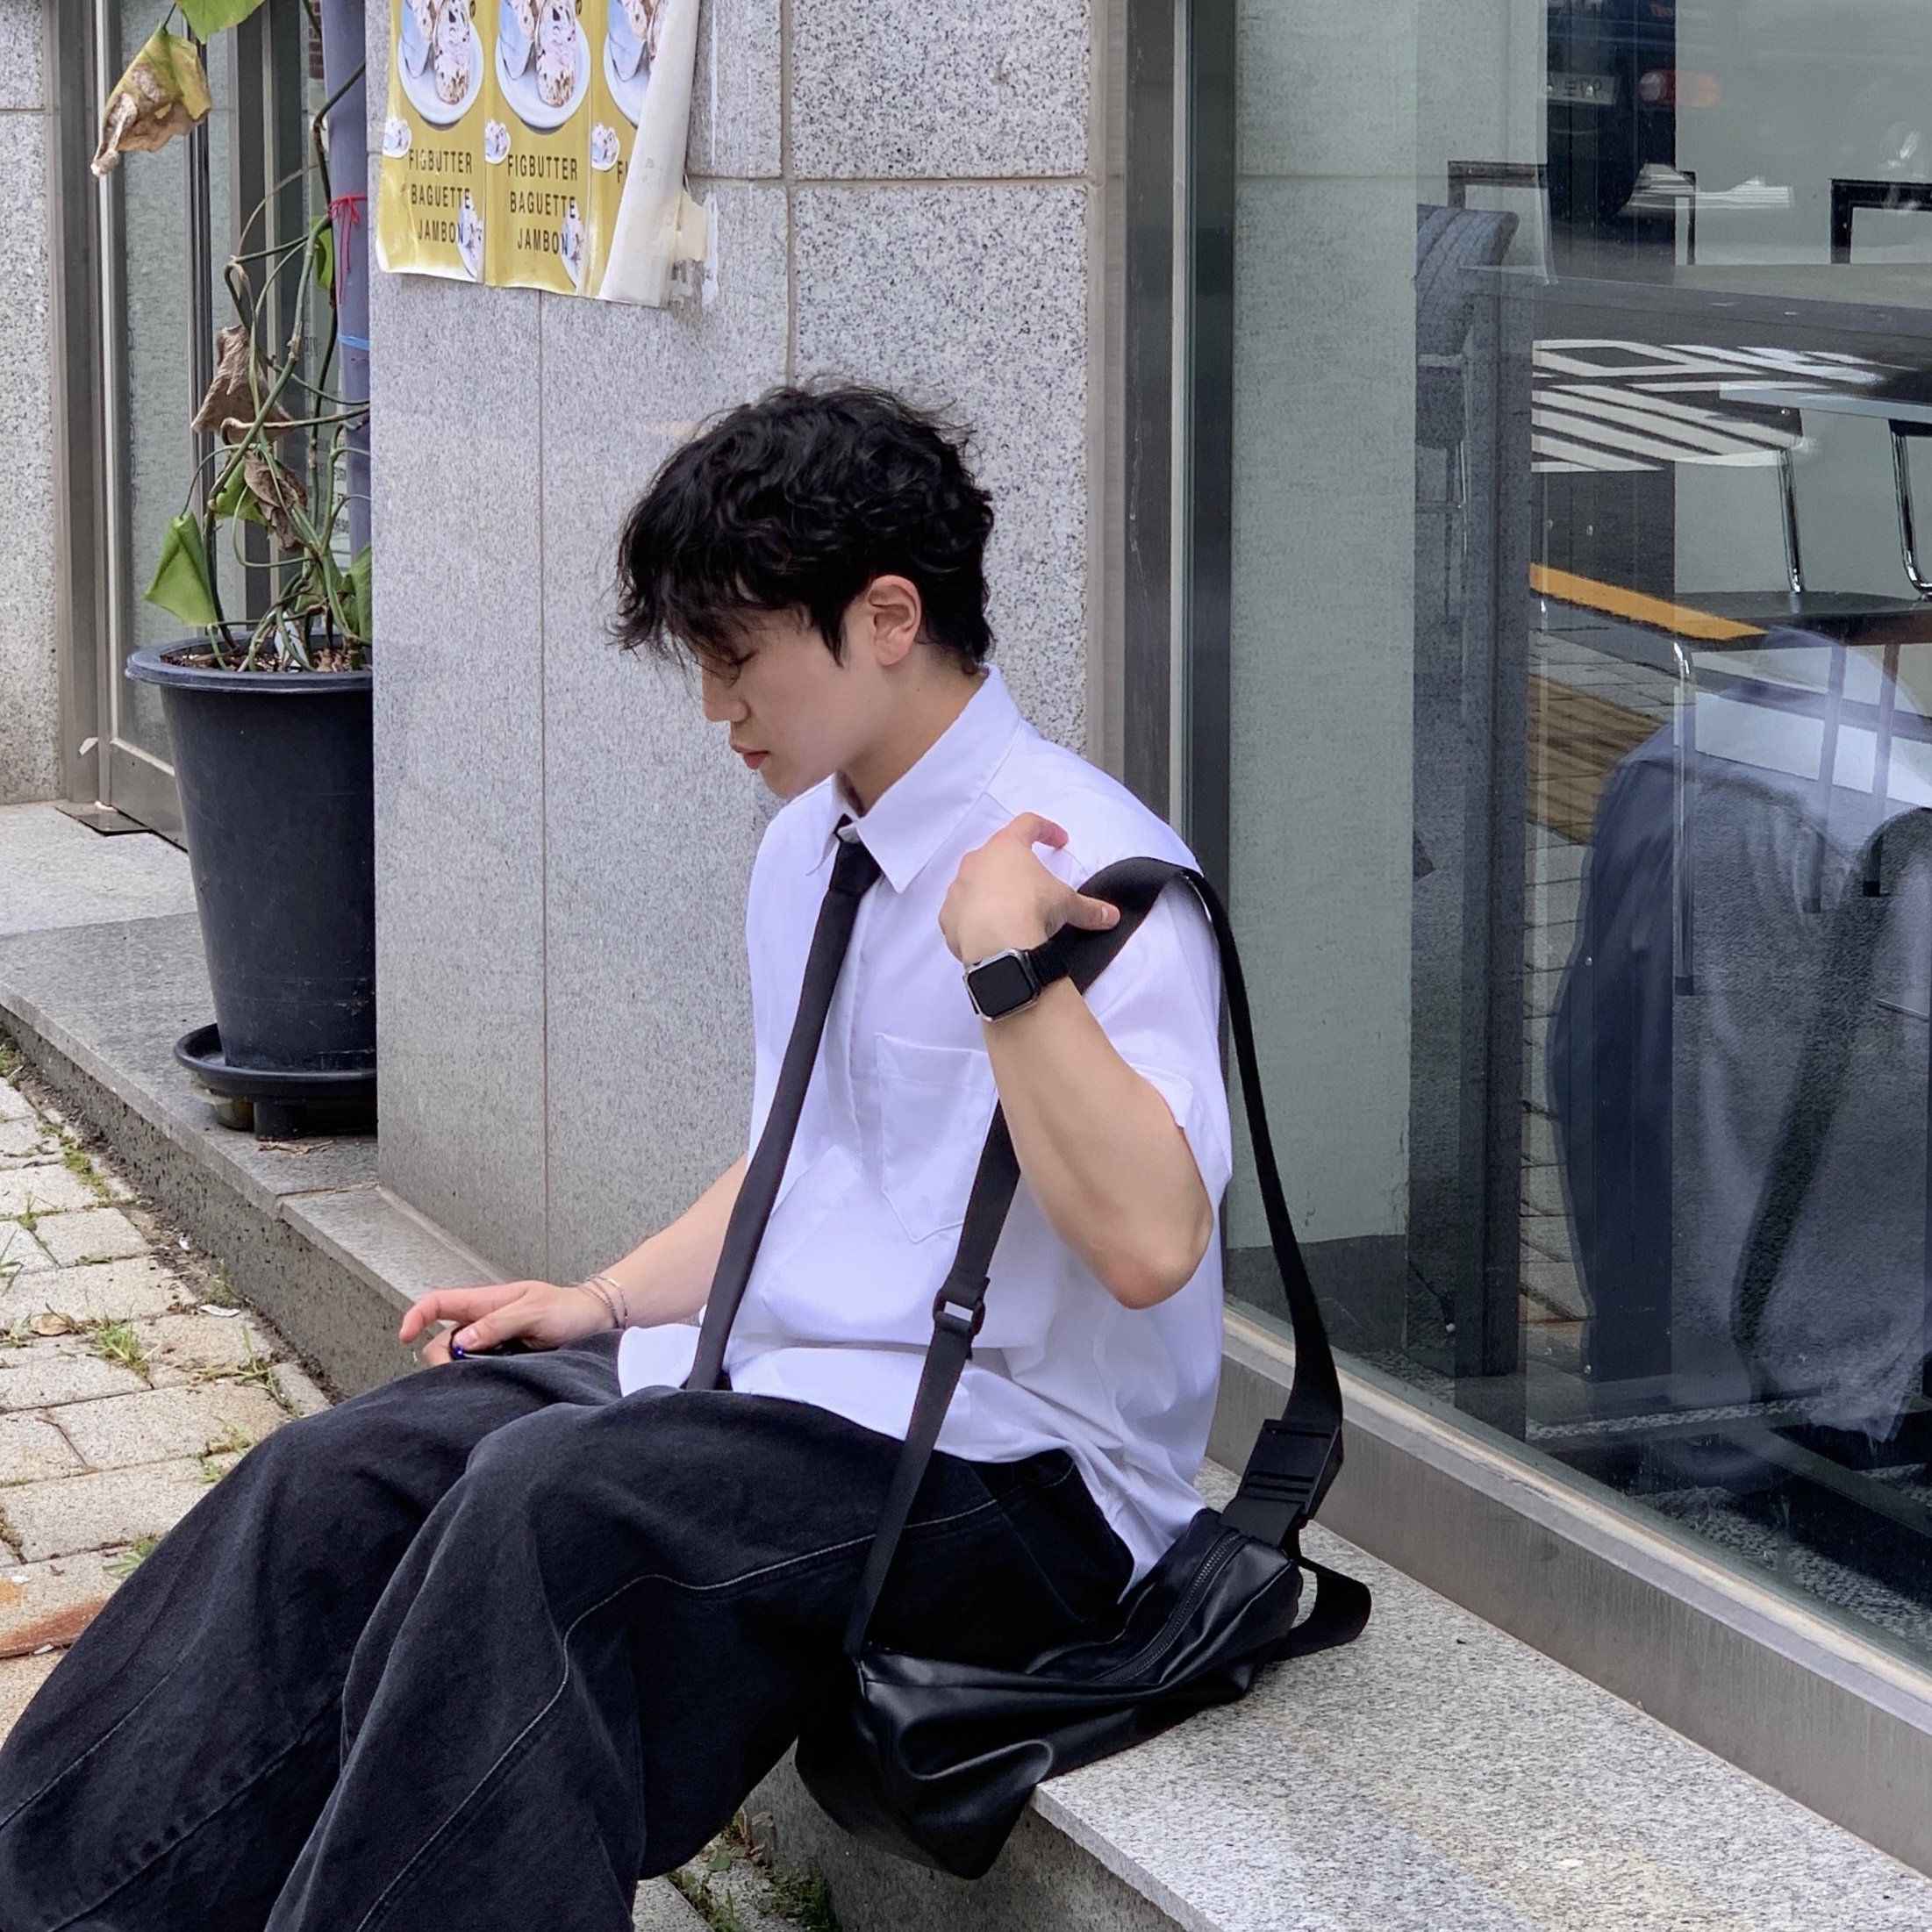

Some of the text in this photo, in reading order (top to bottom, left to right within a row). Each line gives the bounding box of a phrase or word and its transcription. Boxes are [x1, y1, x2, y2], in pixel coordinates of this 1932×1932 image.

[409, 149, 472, 174] FIGBUTTER
[508, 154, 578, 181] FIGBUTTER
[411, 184, 470, 210] BAGUETTE
[510, 191, 576, 218] BAGUETTE
[419, 219, 464, 244] JAMBON
[518, 228, 569, 256] JAMBON
